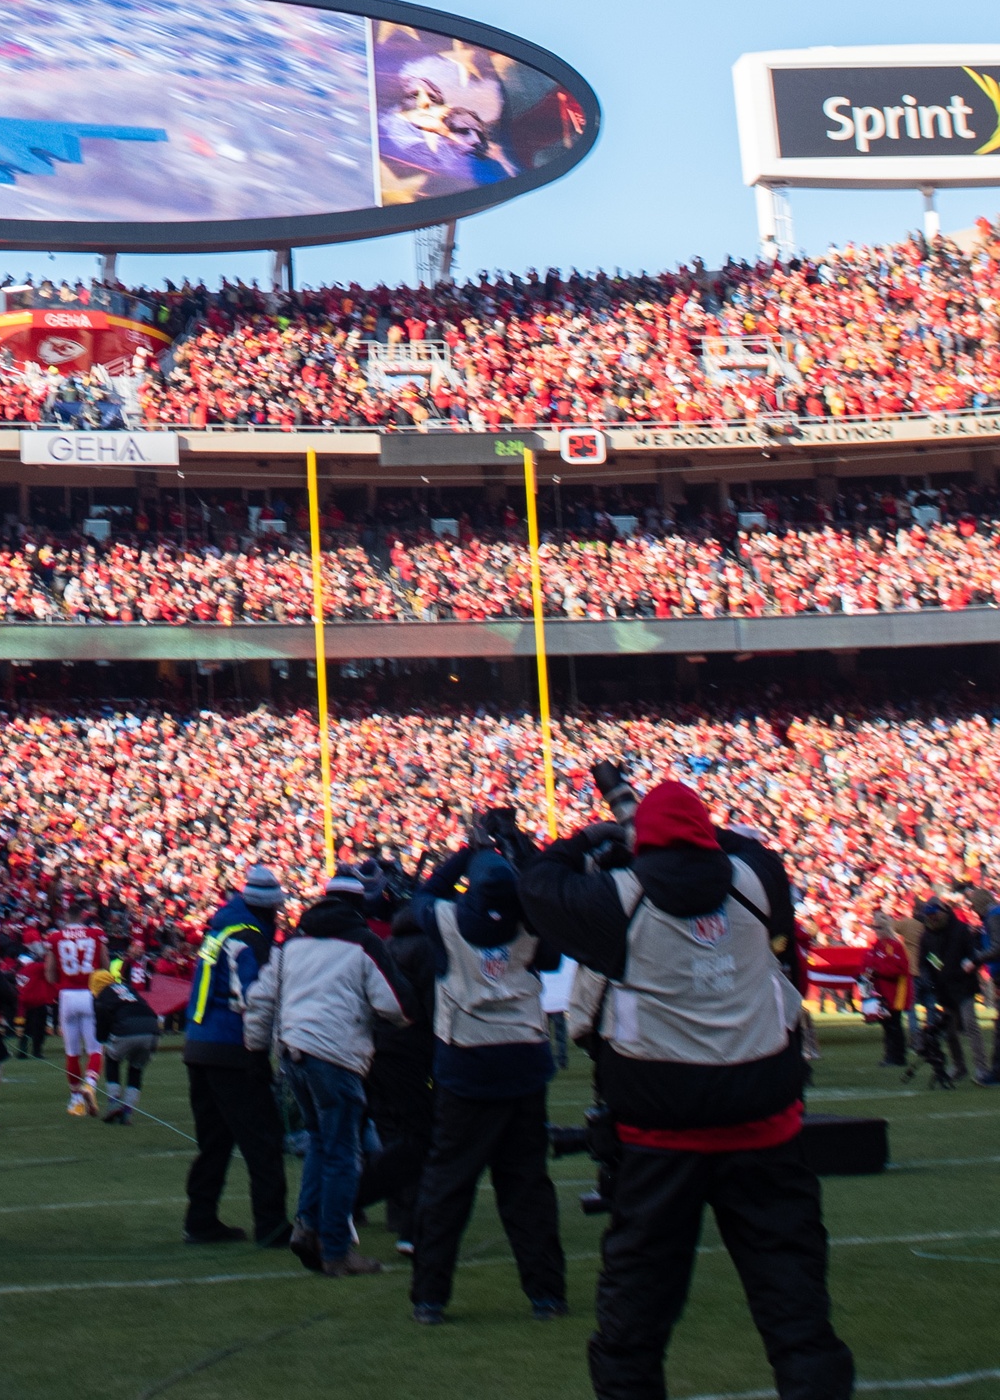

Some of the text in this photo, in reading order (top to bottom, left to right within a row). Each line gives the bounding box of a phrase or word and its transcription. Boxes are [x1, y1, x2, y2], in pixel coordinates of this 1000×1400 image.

[822, 94, 976, 152] Sprint
[44, 313, 93, 328] GEHA
[47, 436, 146, 461] GEHA
[569, 435, 597, 458] 25
[57, 937, 96, 976] 87
